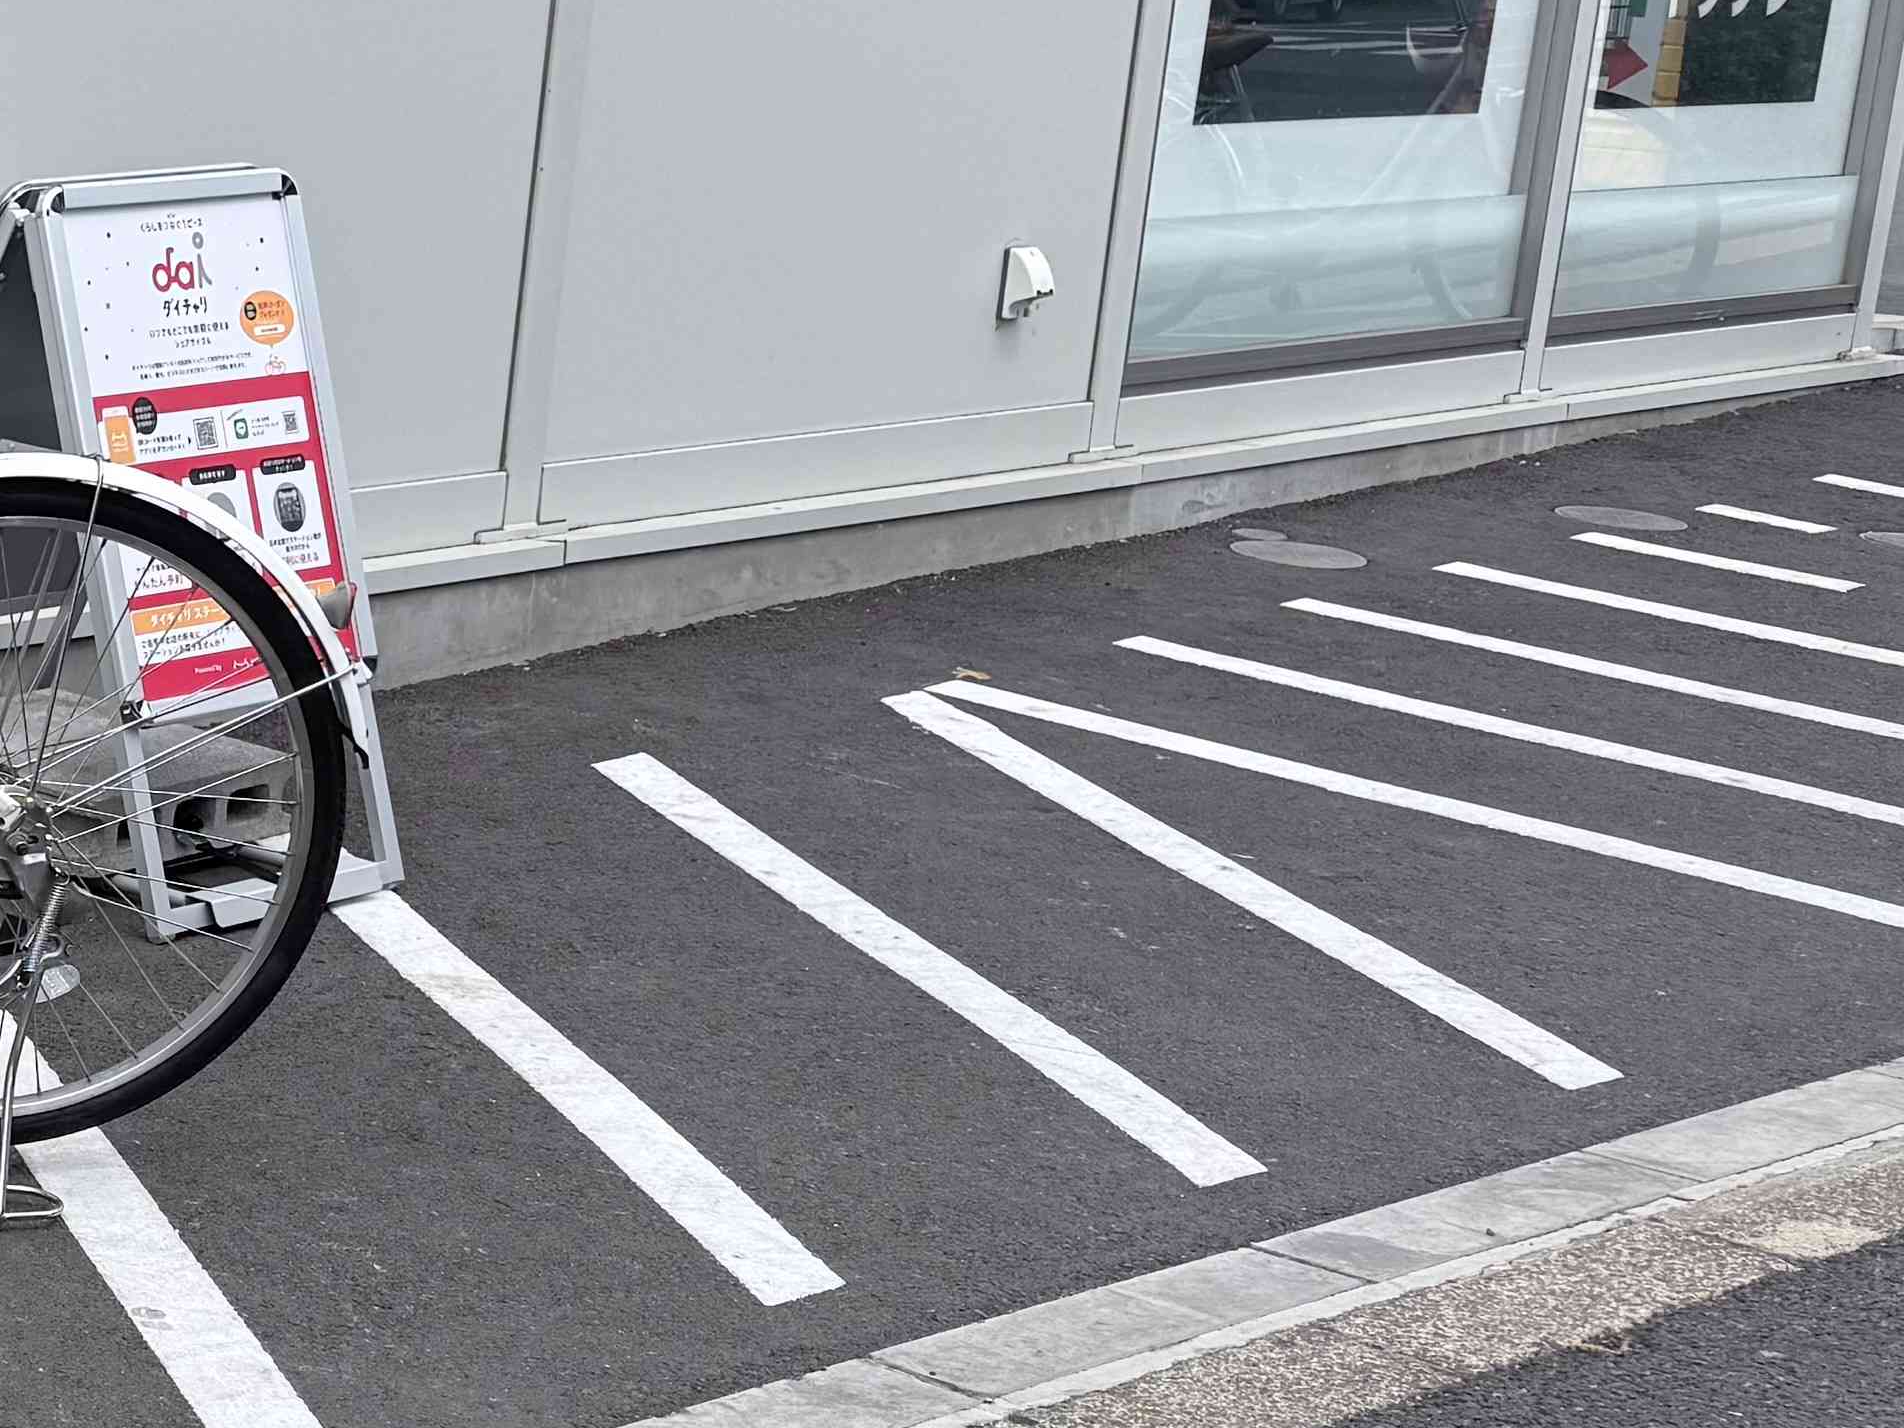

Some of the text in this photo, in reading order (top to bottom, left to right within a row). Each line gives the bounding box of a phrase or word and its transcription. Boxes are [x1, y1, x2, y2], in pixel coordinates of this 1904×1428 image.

[163, 296, 208, 317] ダイチャリ
